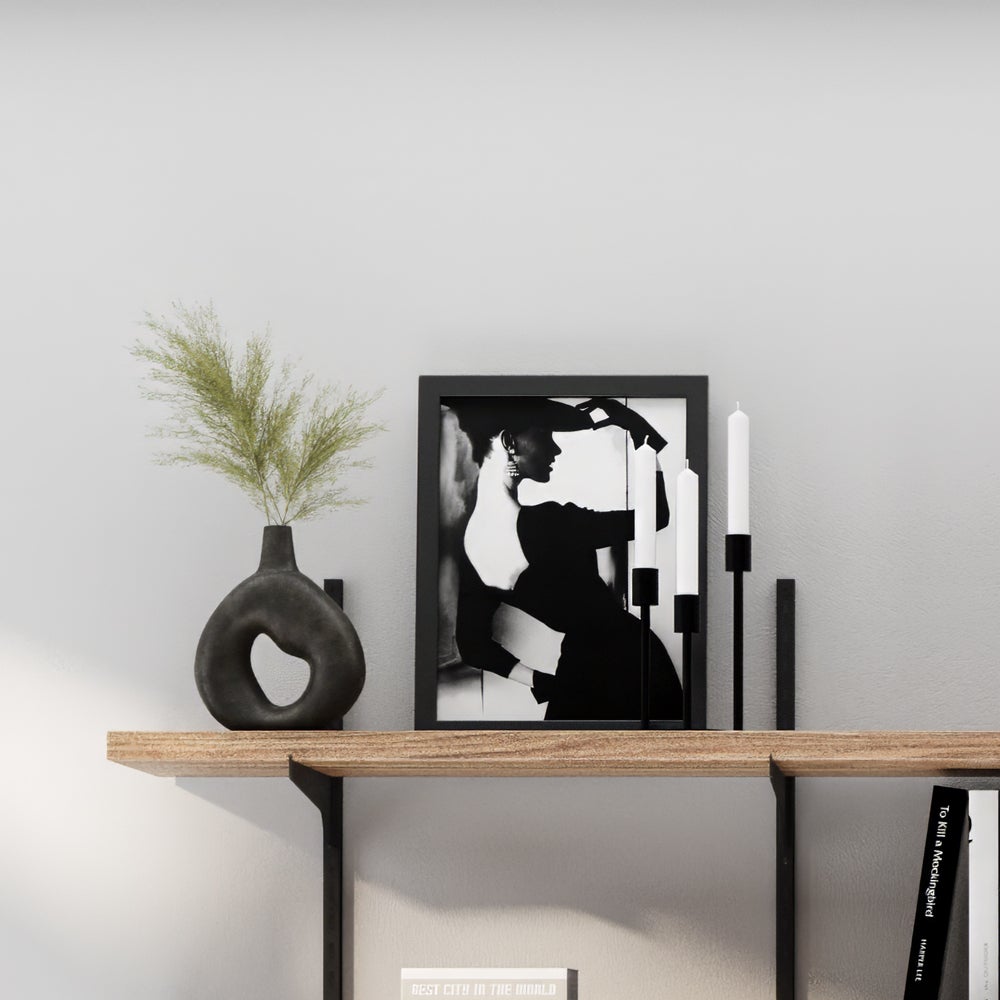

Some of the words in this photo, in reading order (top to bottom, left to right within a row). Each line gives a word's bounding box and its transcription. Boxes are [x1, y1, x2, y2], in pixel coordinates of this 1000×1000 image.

[939, 805, 950, 818] To
[936, 821, 948, 837] Kill
[925, 850, 943, 917] Mockingbird
[490, 983, 511, 996] THE
